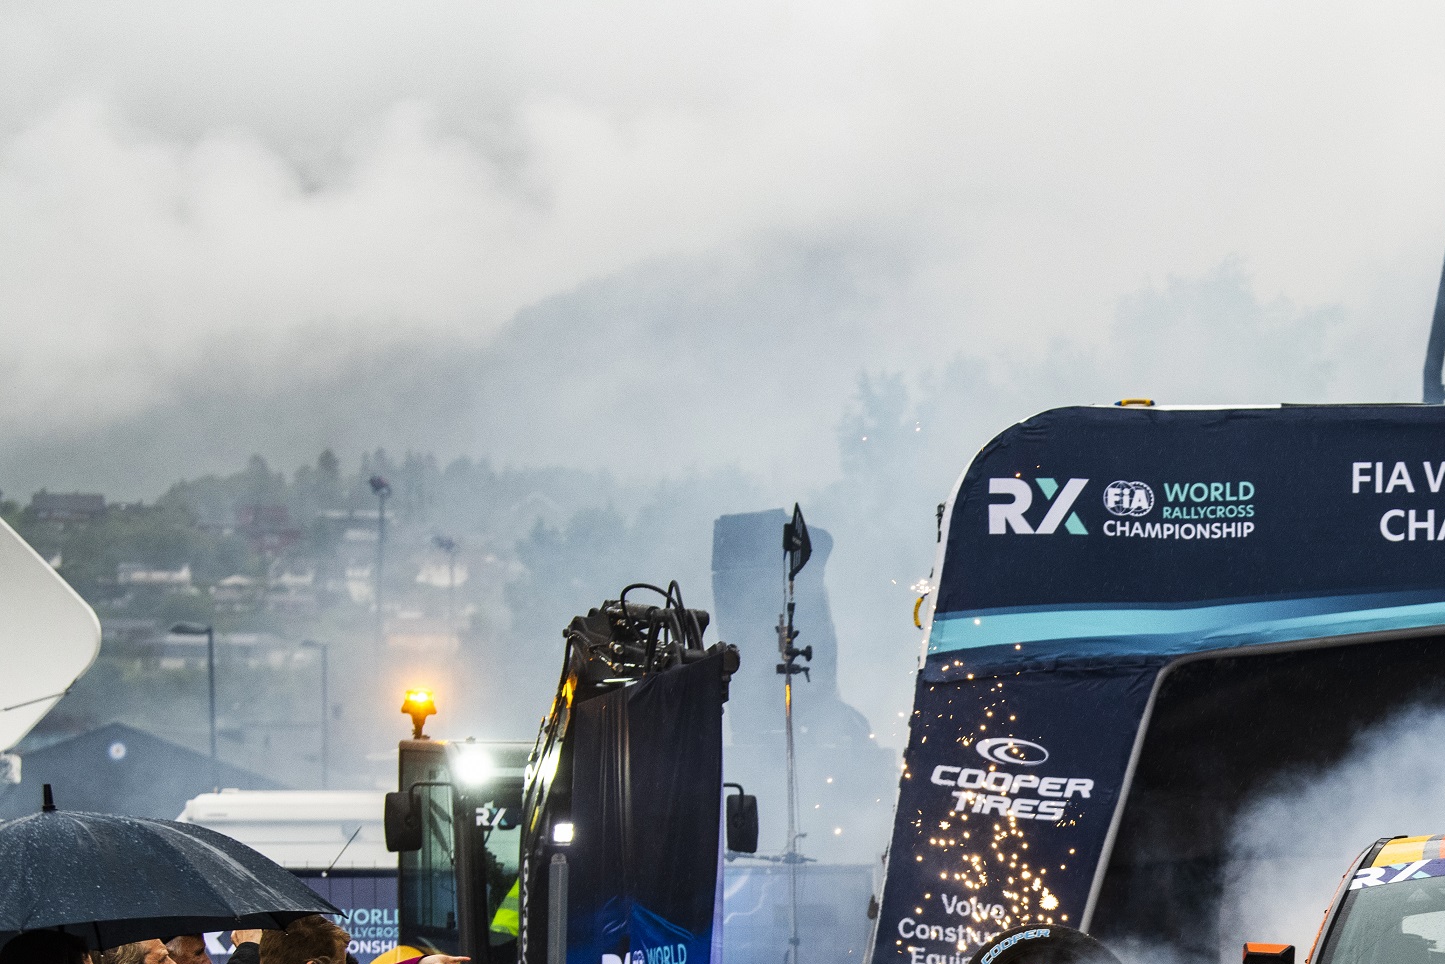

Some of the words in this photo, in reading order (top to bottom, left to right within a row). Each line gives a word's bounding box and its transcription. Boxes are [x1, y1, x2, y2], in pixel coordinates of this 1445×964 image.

[1352, 461, 1415, 493] FIA
[988, 477, 1090, 535] RX
[1163, 481, 1255, 503] WORLD
[1162, 504, 1255, 519] RALLYCROSS
[1102, 520, 1255, 540] CHAMPIONSHIP
[930, 765, 1094, 799] COOPER
[475, 807, 507, 826] RX
[951, 790, 1066, 821] TIRES
[1349, 859, 1432, 890] RX
[941, 893, 1006, 919] Volvo
